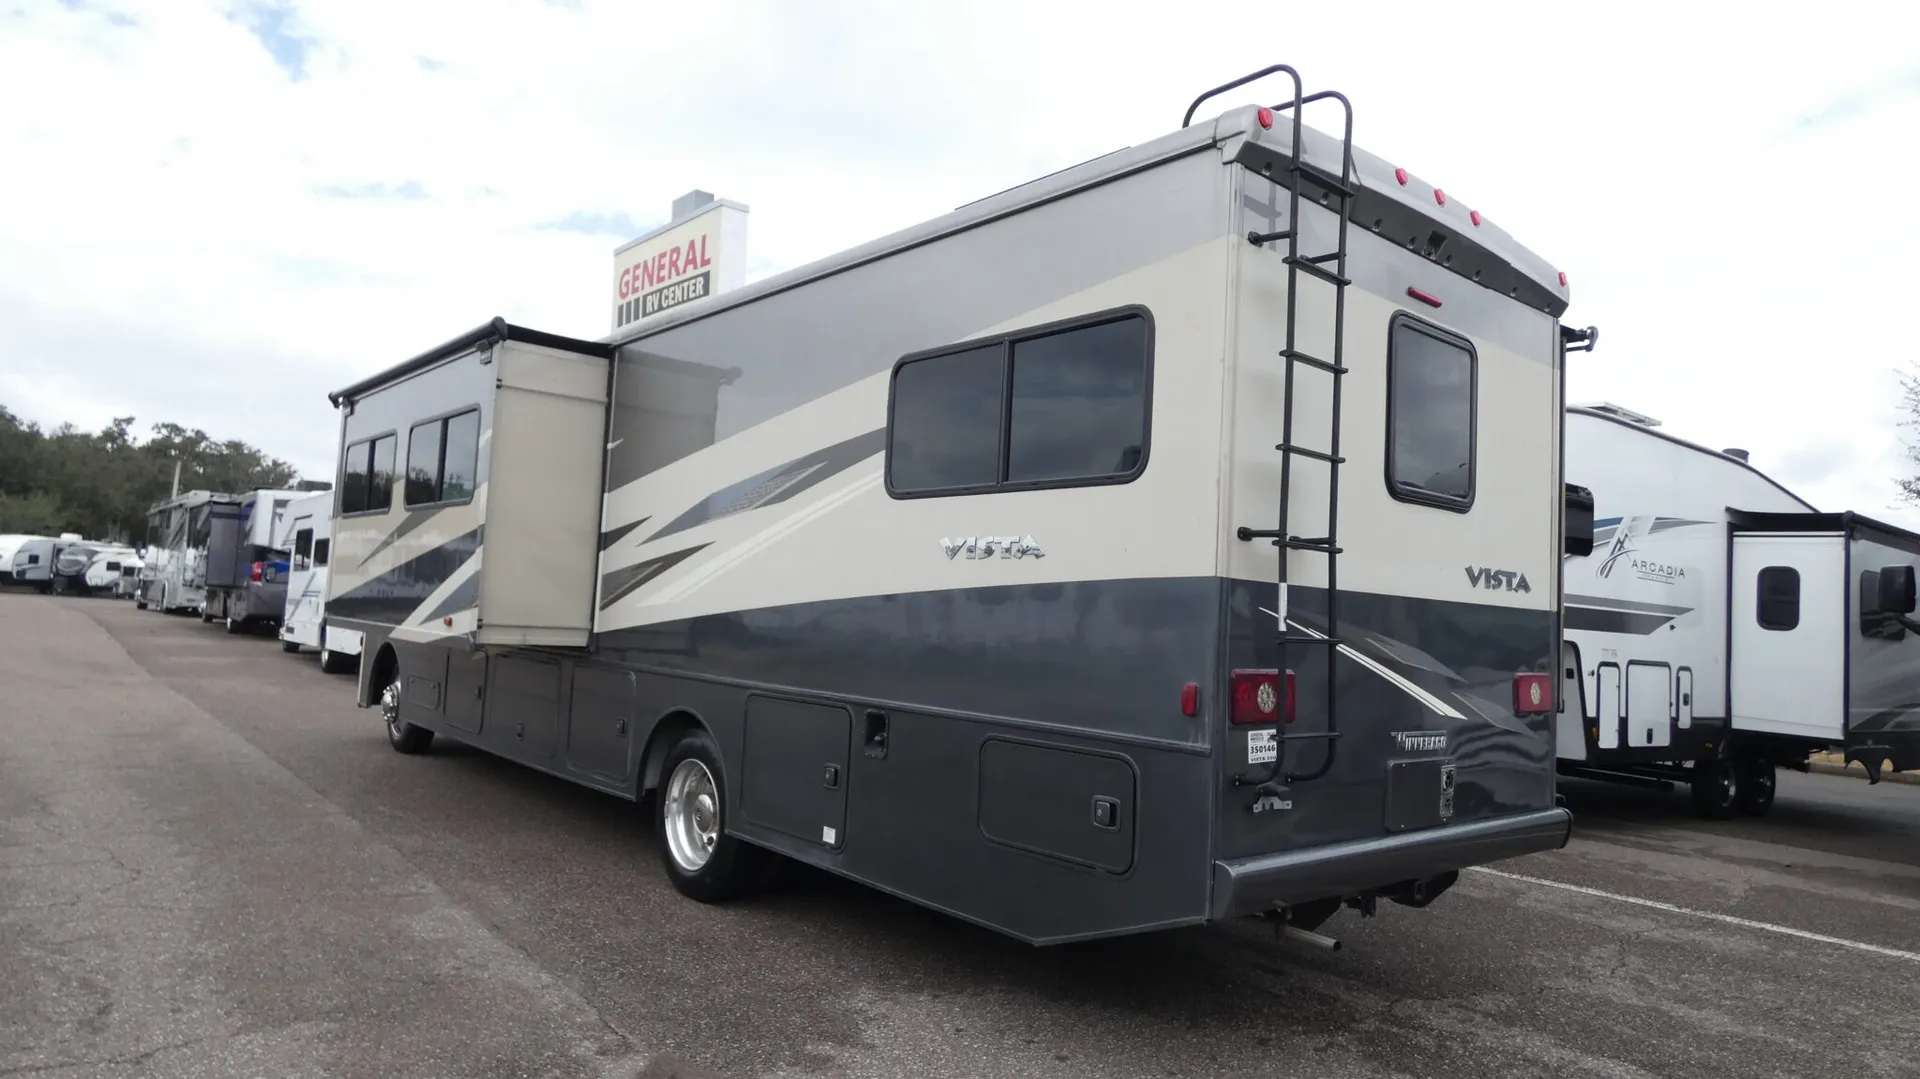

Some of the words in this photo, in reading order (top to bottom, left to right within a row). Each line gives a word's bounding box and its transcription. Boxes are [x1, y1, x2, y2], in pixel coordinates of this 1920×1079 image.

[619, 233, 711, 299] GENERAL
[646, 292, 660, 313] RV
[661, 276, 704, 307] CENTER
[939, 534, 1046, 560] VISTA
[1464, 565, 1531, 593] VISTA
[1631, 559, 1686, 578] ARCADIA
[1250, 745, 1275, 754] 350146
